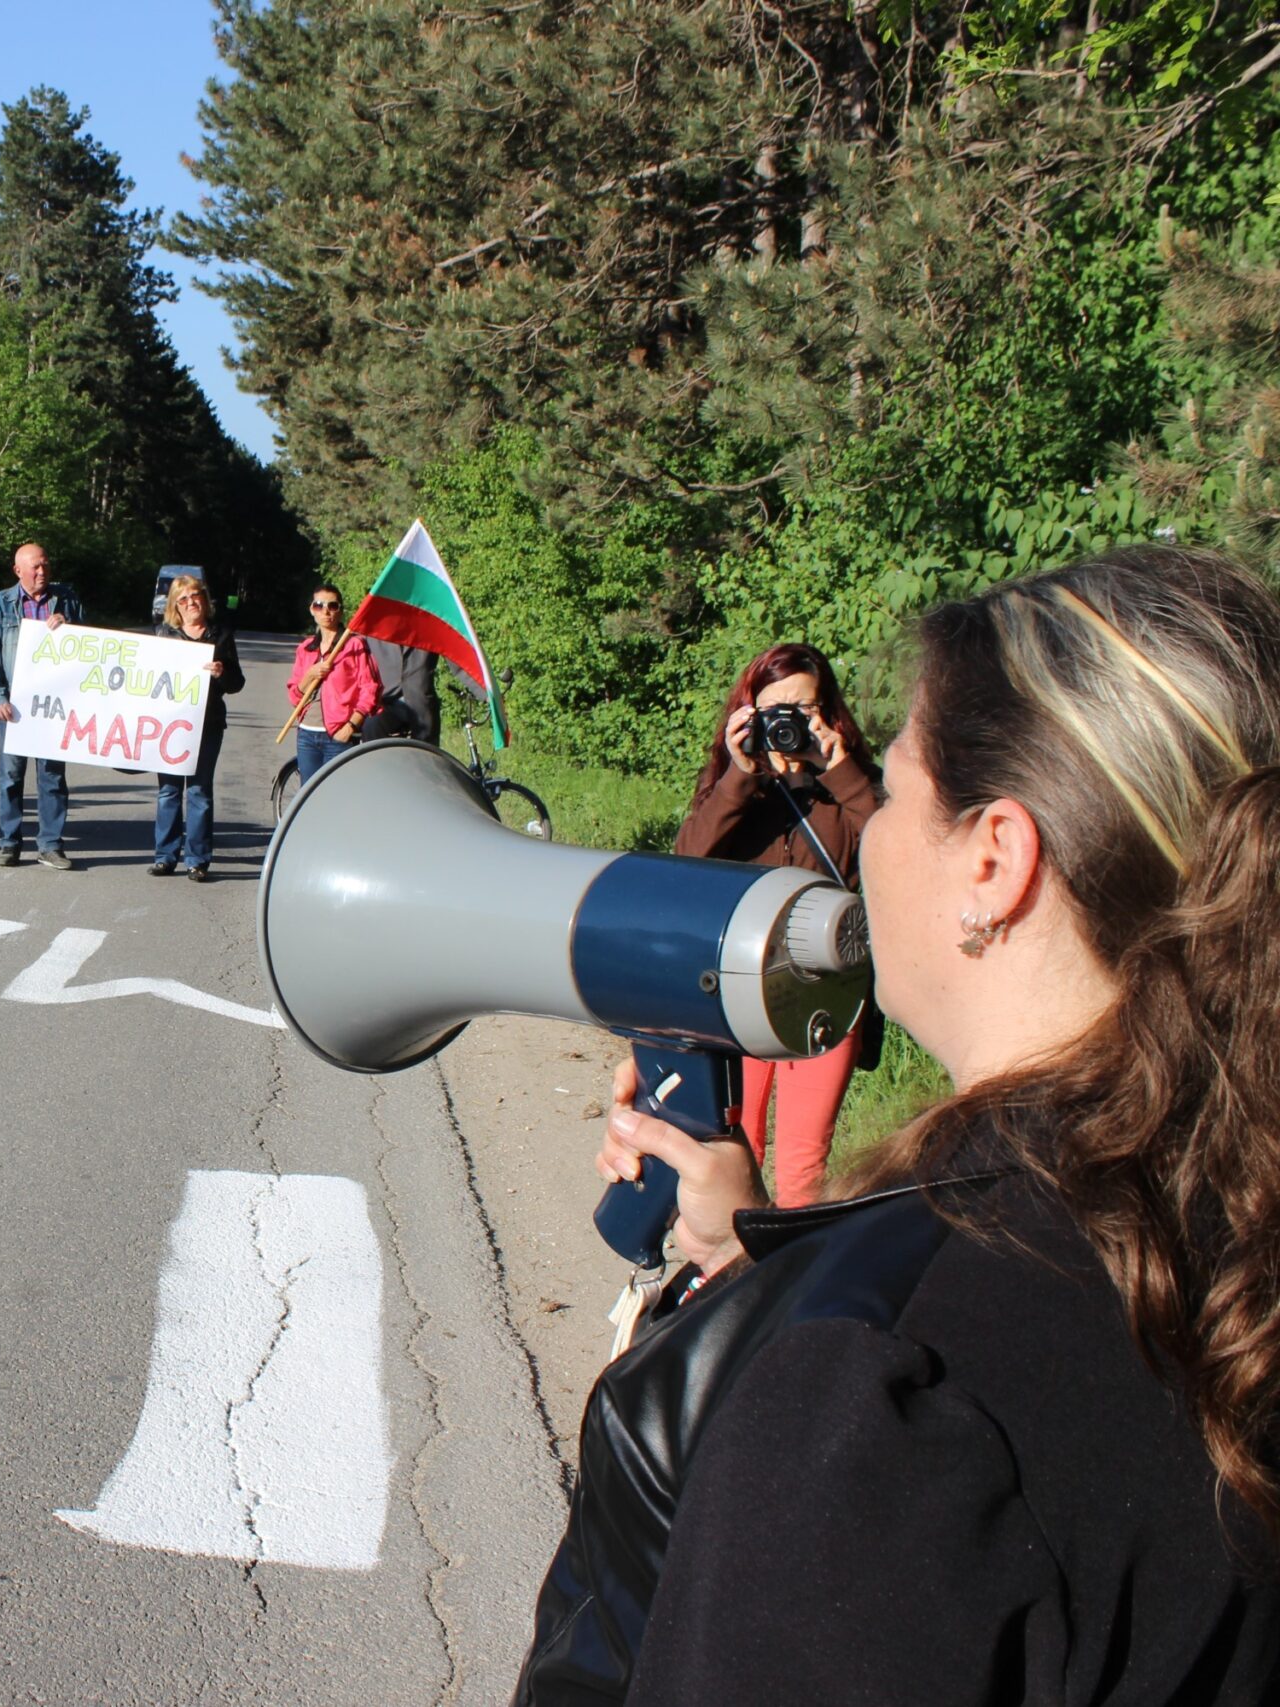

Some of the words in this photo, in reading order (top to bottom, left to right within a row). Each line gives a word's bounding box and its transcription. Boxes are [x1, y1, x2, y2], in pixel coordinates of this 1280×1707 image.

[32, 633, 139, 667] ДОБРЕ
[80, 665, 200, 705] ДОШЛИ
[31, 694, 66, 720] НА
[60, 709, 193, 765] МАРС
